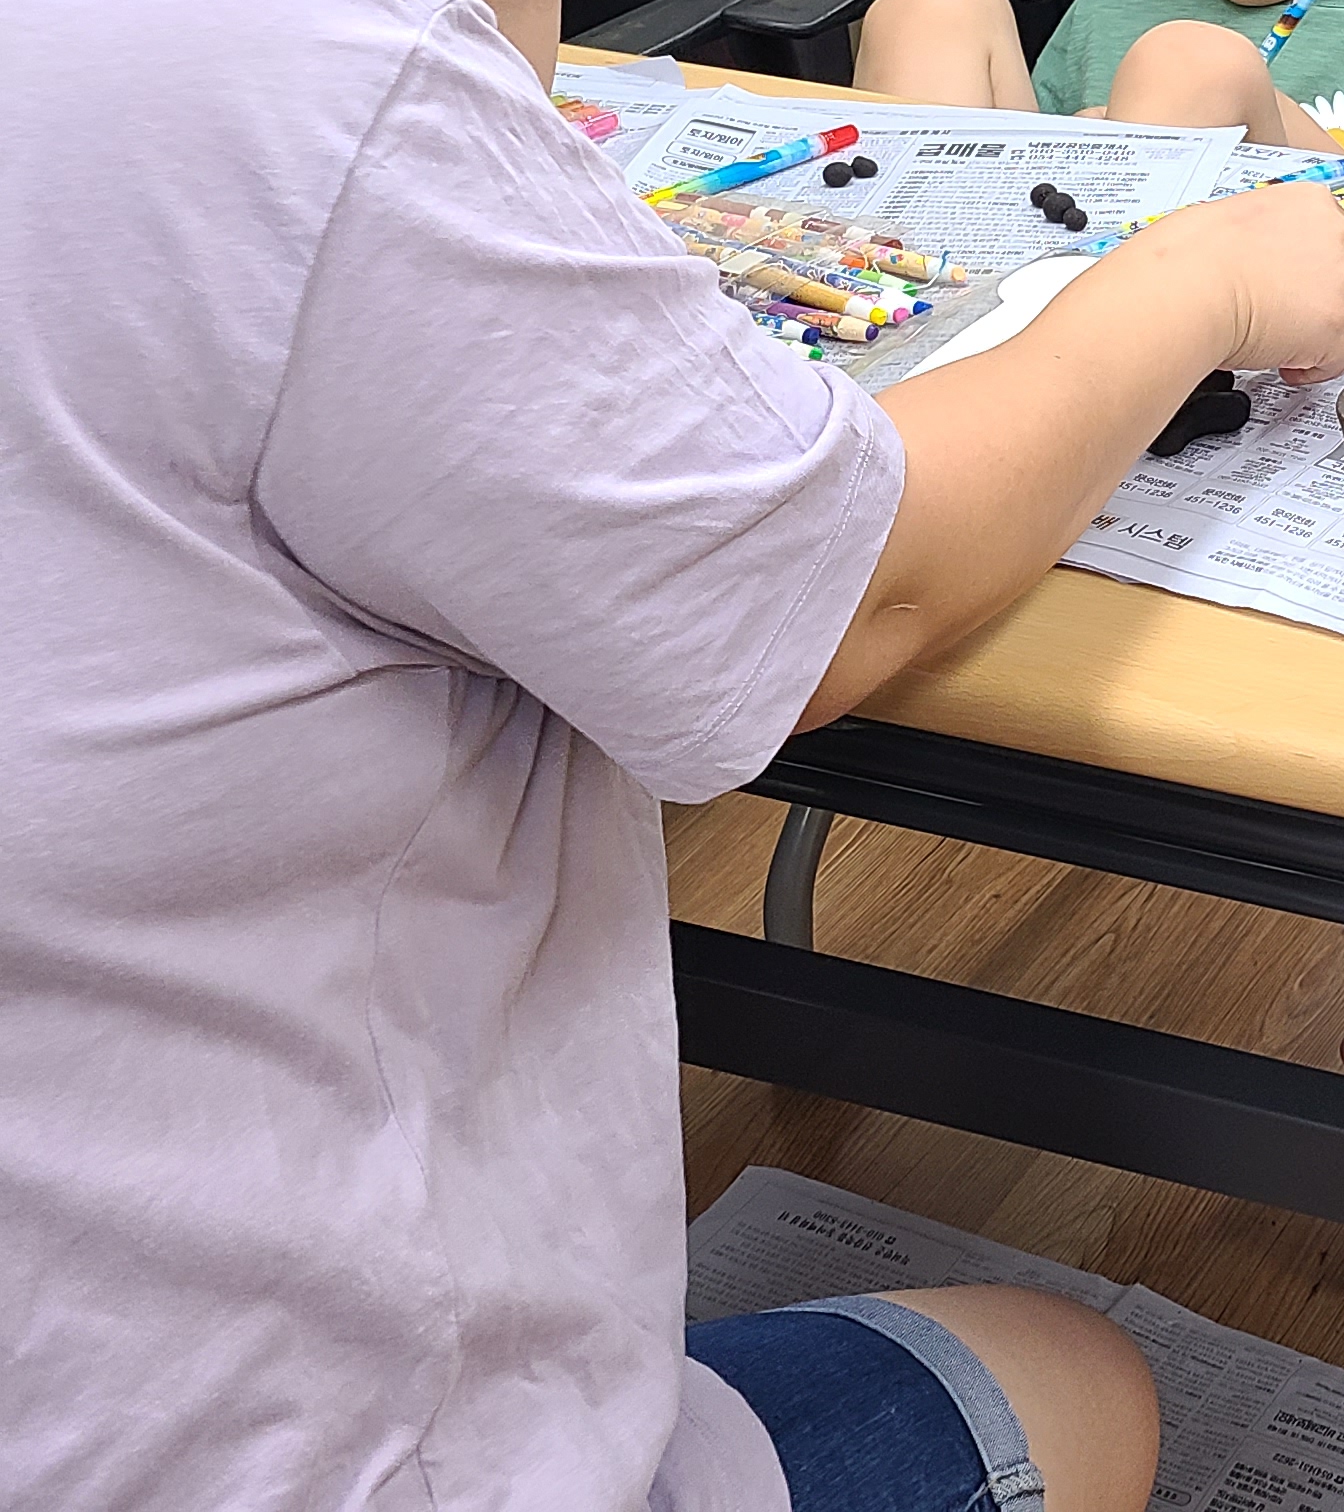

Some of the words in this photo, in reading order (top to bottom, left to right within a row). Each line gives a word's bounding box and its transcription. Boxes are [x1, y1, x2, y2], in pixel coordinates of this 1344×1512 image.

[915, 143, 1007, 158] 급매물
[1133, 473, 1178, 490] 문의전화
[1201, 488, 1247, 504] 문의전화
[1271, 507, 1316, 527] 문의전화
[1183, 495, 1243, 515] 451-1236
[1253, 515, 1313, 539] 451-1236
[1118, 521, 1193, 551] 시스템
[1274, 1409, 1336, 1438] 비교해보세요!
